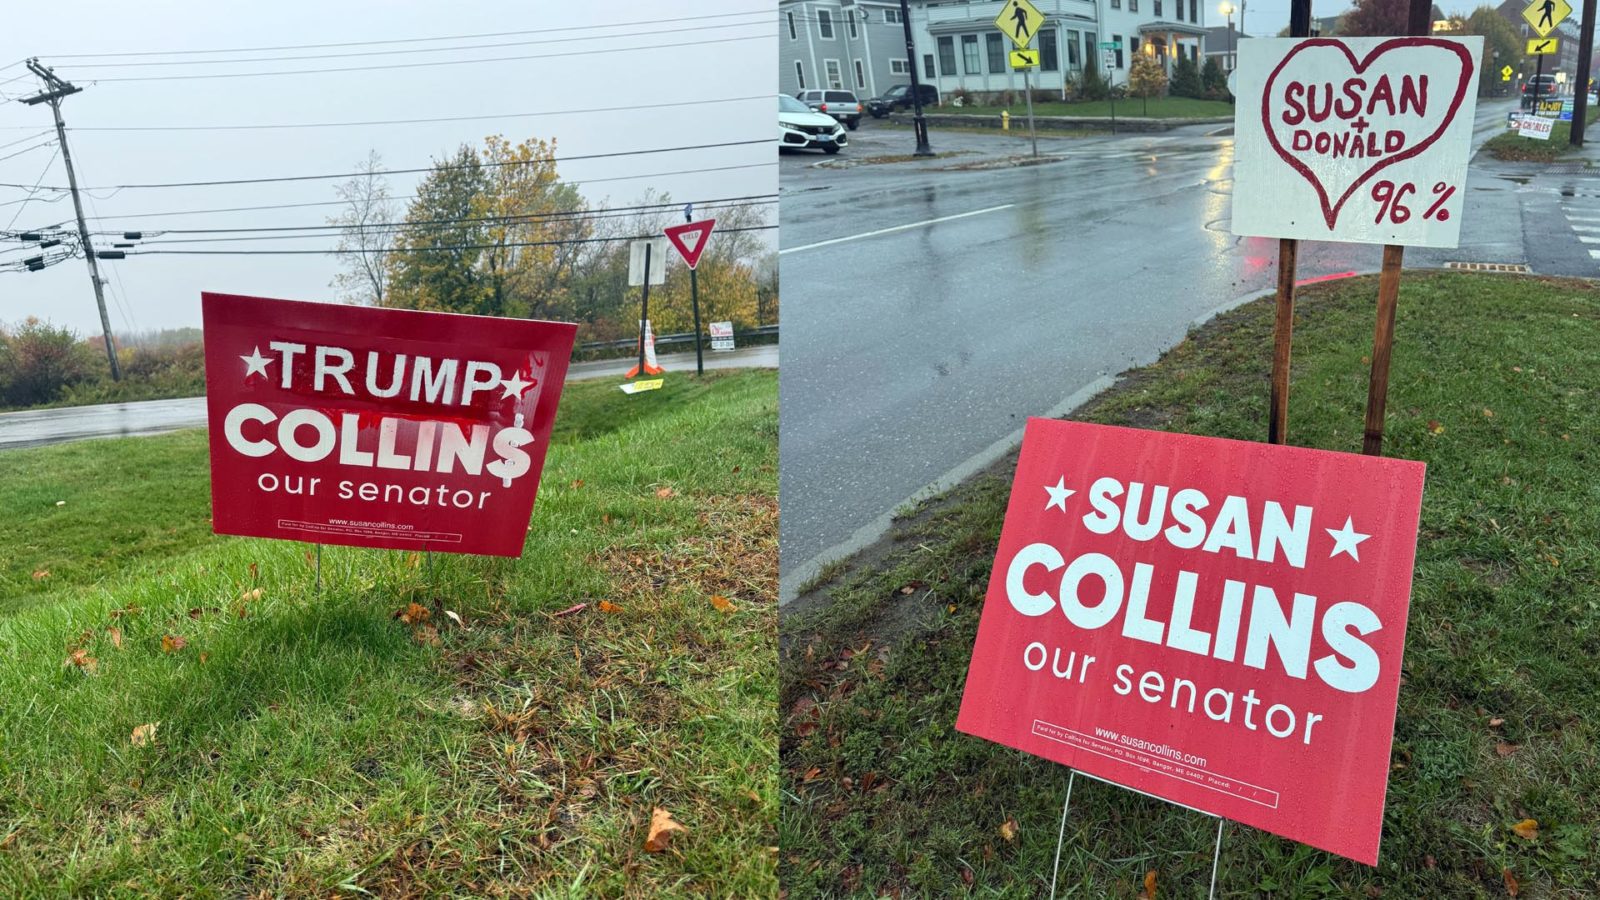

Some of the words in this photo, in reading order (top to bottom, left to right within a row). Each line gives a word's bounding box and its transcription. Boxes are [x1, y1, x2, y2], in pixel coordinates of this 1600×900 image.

[1282, 74, 1428, 125] SUSAN
[1292, 130, 1405, 158] DONALD
[1350, 116, 1369, 133] +
[682, 232, 699, 240] YIELD
[270, 341, 502, 406] TRUMP
[258, 473, 321, 496] our
[338, 480, 491, 509] senator
[328, 518, 414, 531] www.susancollins.com
[1082, 476, 1313, 569] SUSAN
[1005, 542, 1383, 694] COLLINS
[1023, 641, 1096, 684] our
[1112, 663, 1323, 745] senator
[1064, 733, 1082, 743] Collins
[1175, 767, 1184, 775] ME
[1095, 726, 1207, 768] www.susancollins.com
